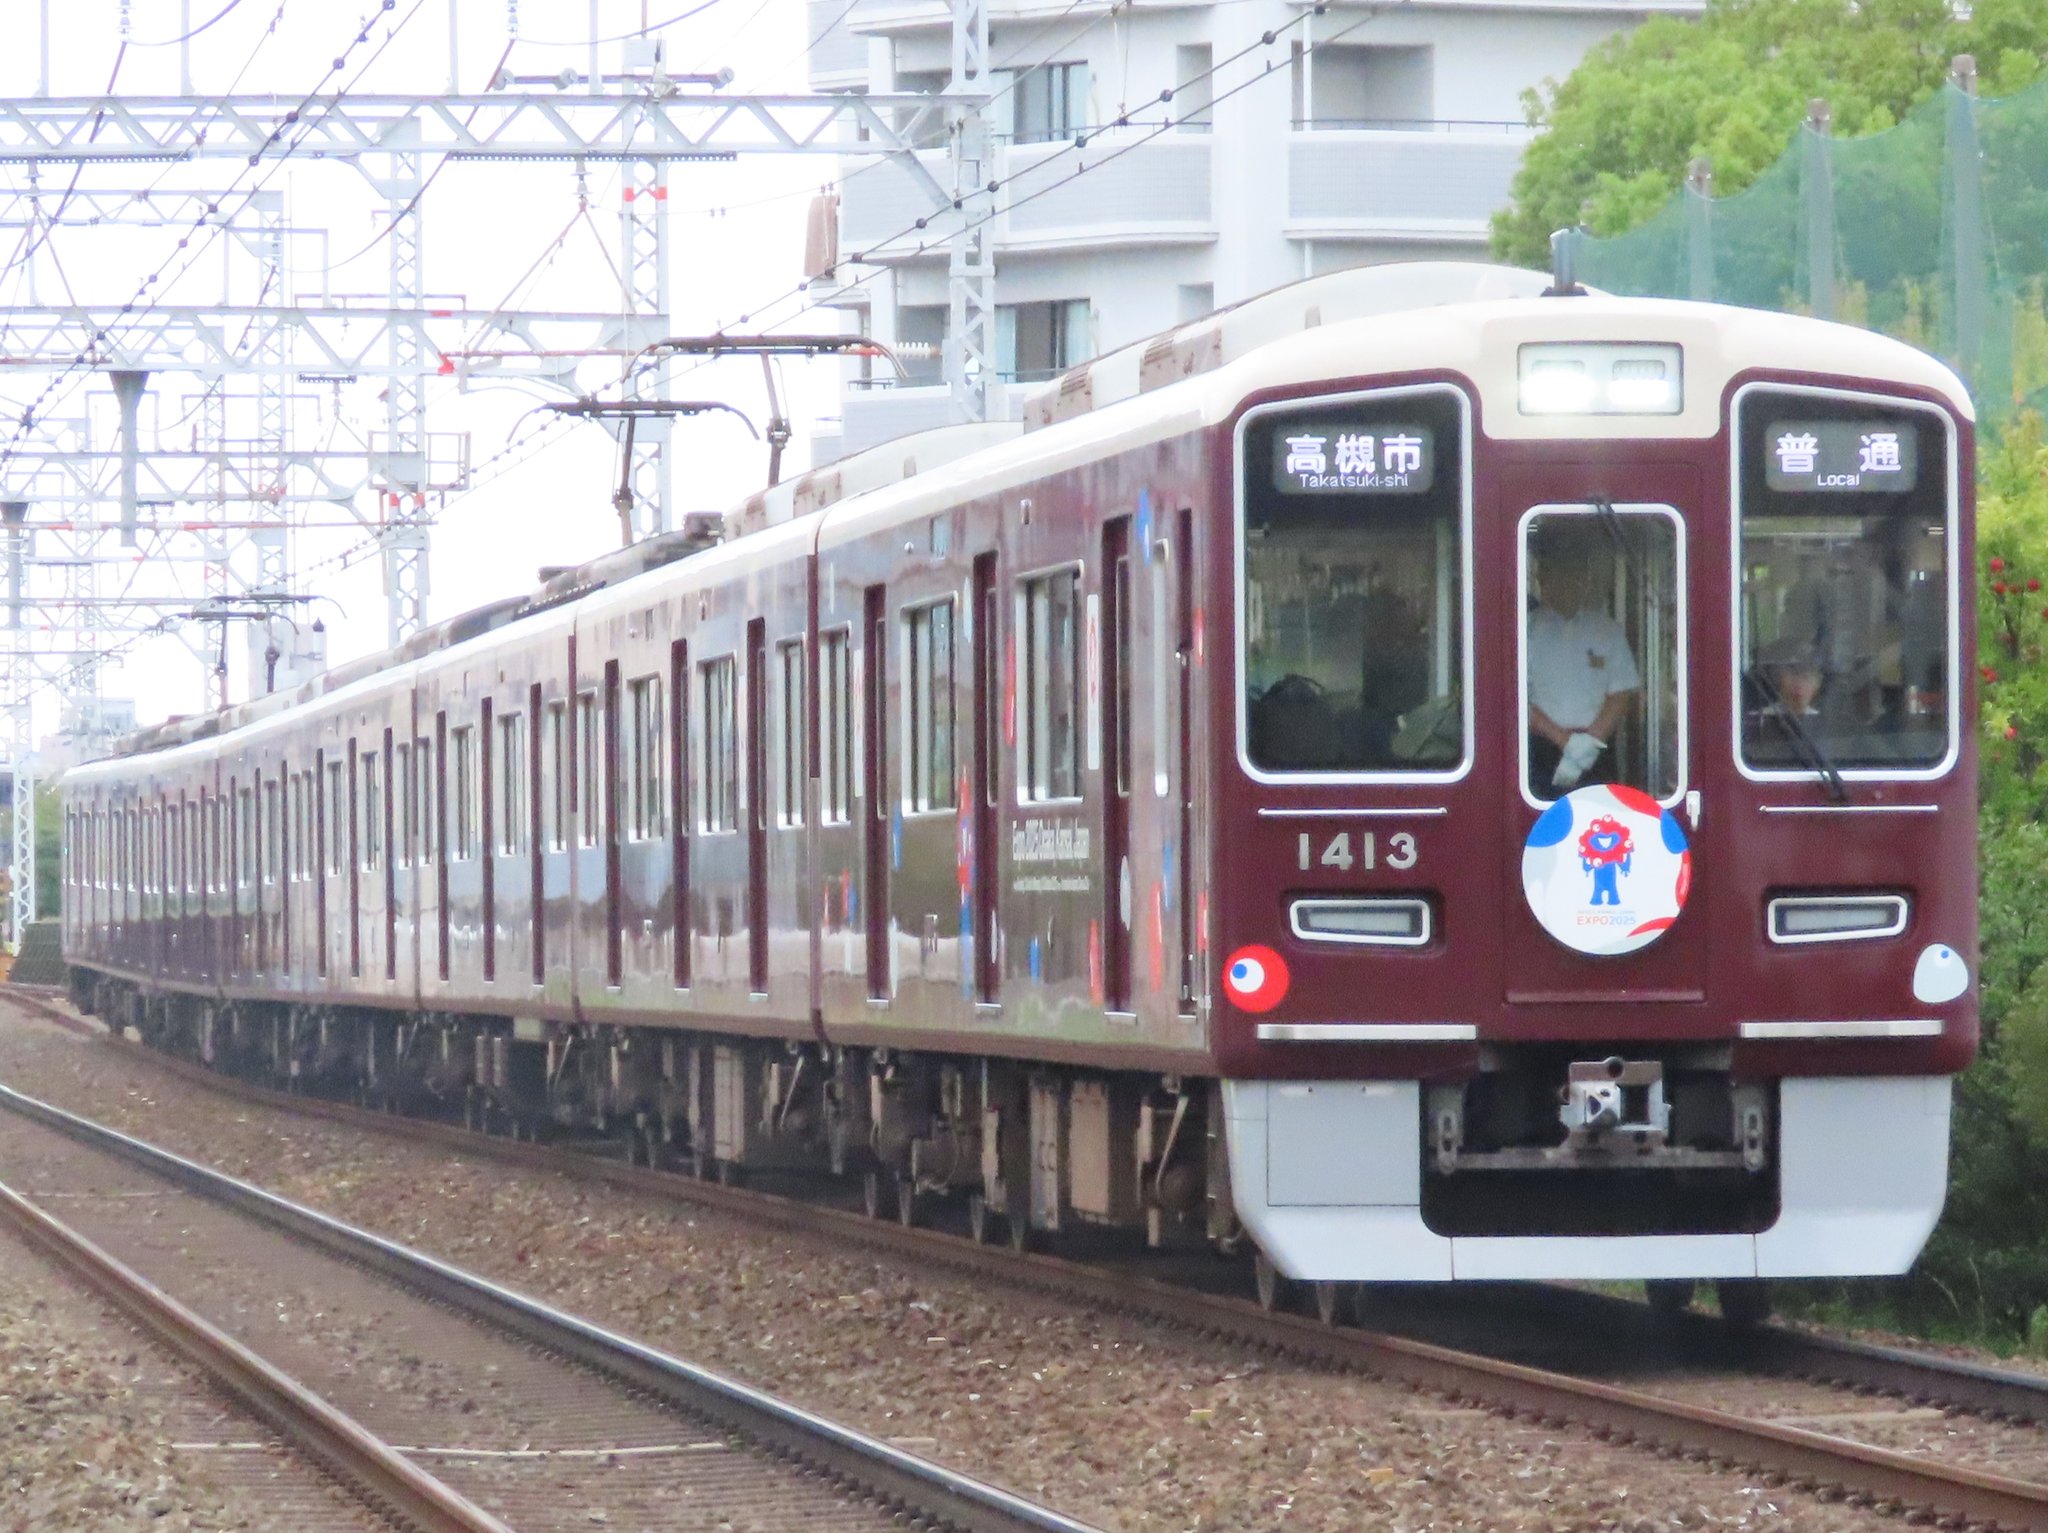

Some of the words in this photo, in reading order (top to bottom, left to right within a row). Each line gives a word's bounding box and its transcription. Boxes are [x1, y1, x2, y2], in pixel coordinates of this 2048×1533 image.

[1285, 433, 1423, 474] 高槻市
[1775, 432, 1902, 473] 普通
[1299, 473, 1409, 488] Takatsuki-shi
[1817, 473, 1860, 487] Local
[1298, 832, 1418, 871] 1413
